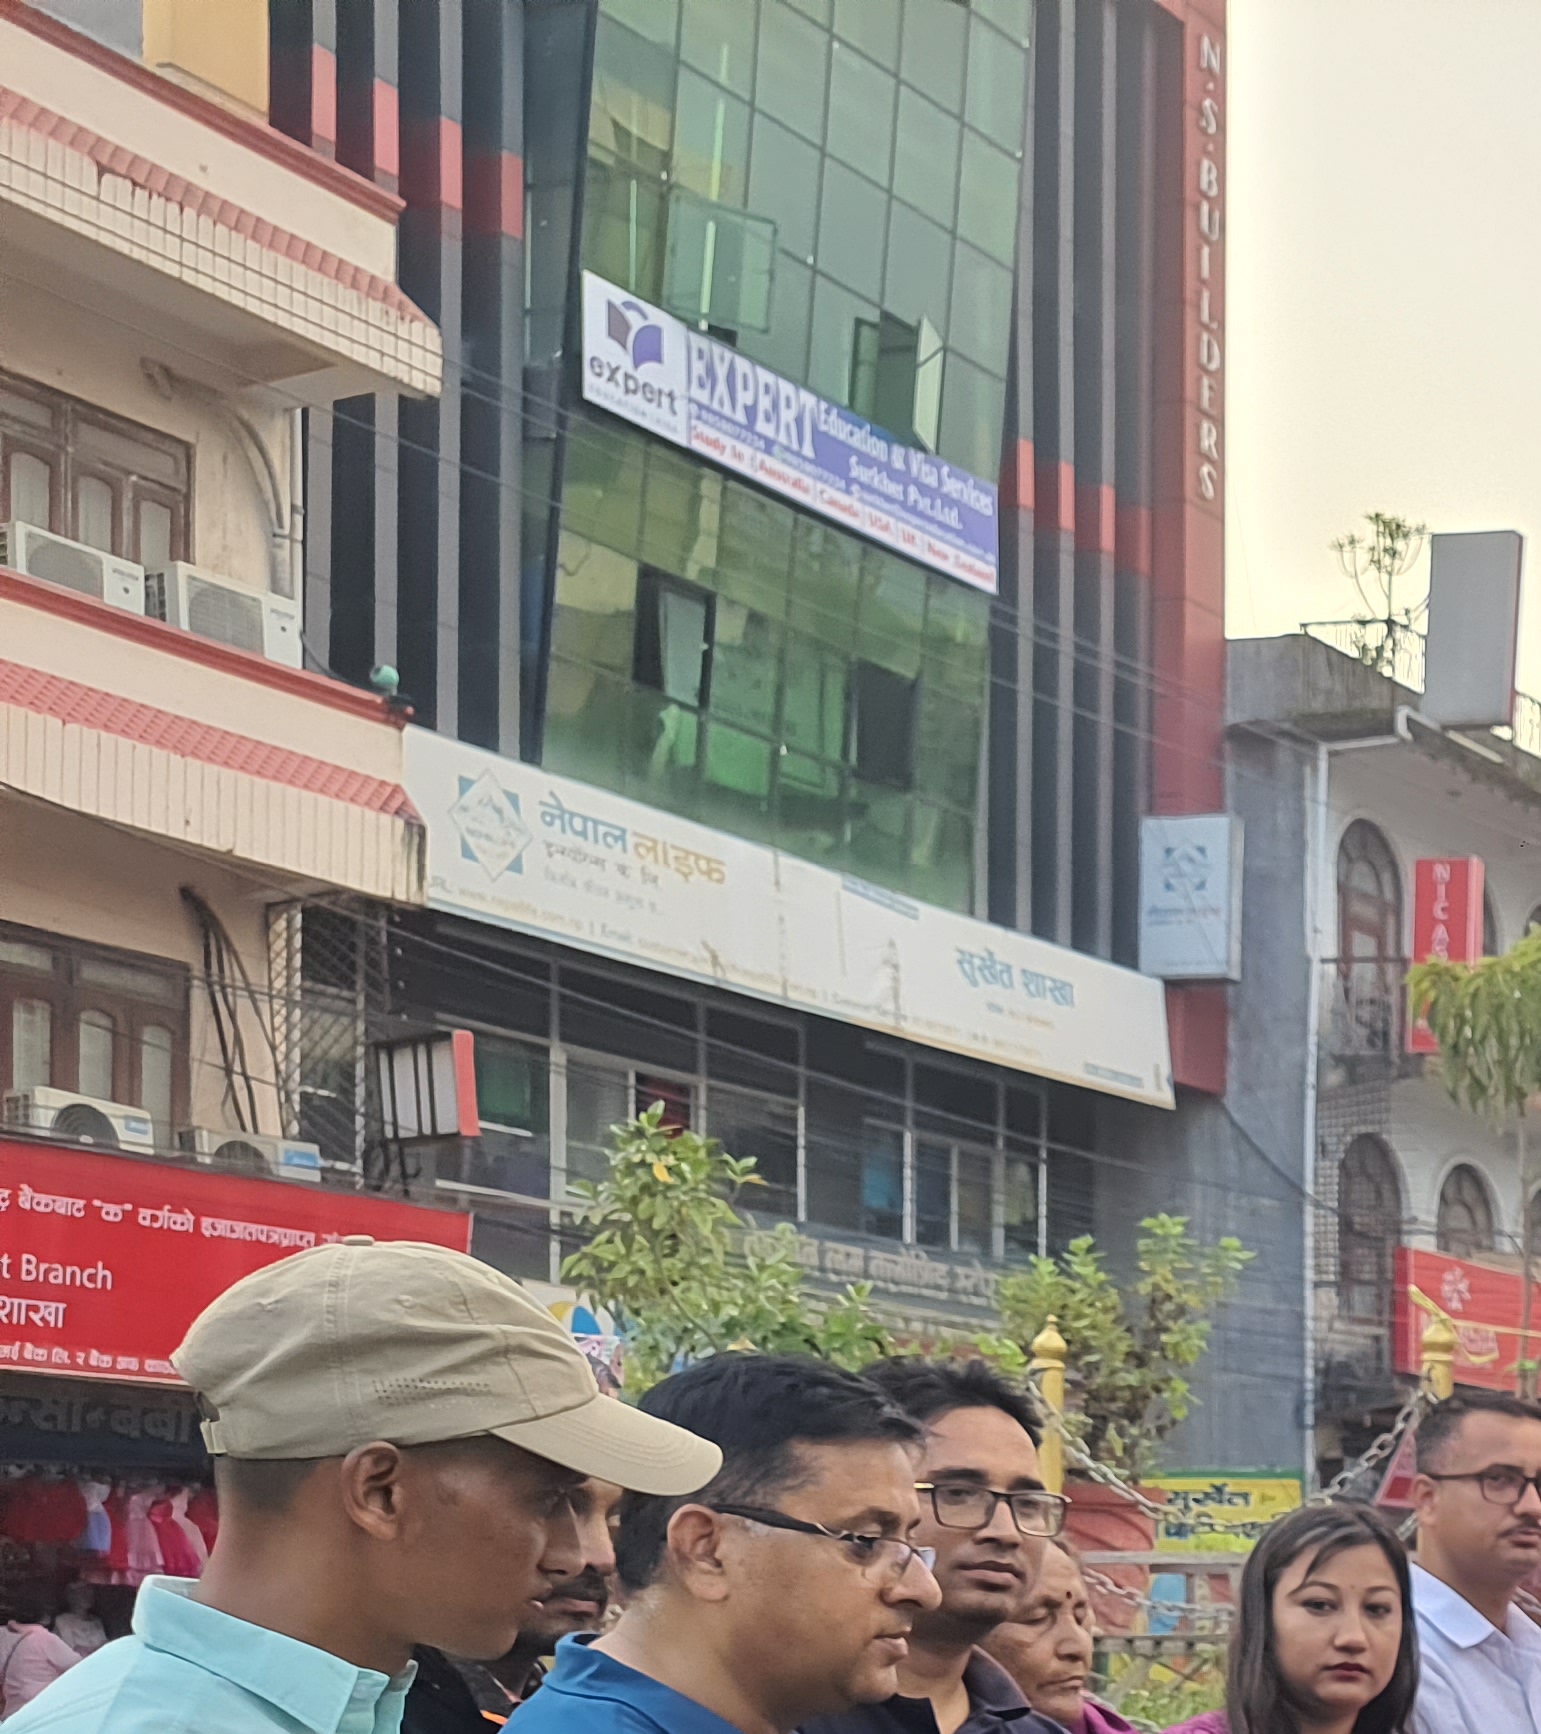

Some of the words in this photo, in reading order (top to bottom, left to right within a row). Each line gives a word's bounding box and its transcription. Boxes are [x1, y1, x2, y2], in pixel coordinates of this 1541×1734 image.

[590, 355, 678, 416] expert
[689, 334, 818, 459] EXPERT
[819, 399, 889, 462] Education
[907, 447, 939, 489] Visa
[940, 464, 993, 516] Services
[539, 790, 628, 853] नेपाल
[632, 831, 726, 885] लाइफ
[138, 1204, 195, 1234] वर्गको
[20, 1252, 113, 1291] Branch
